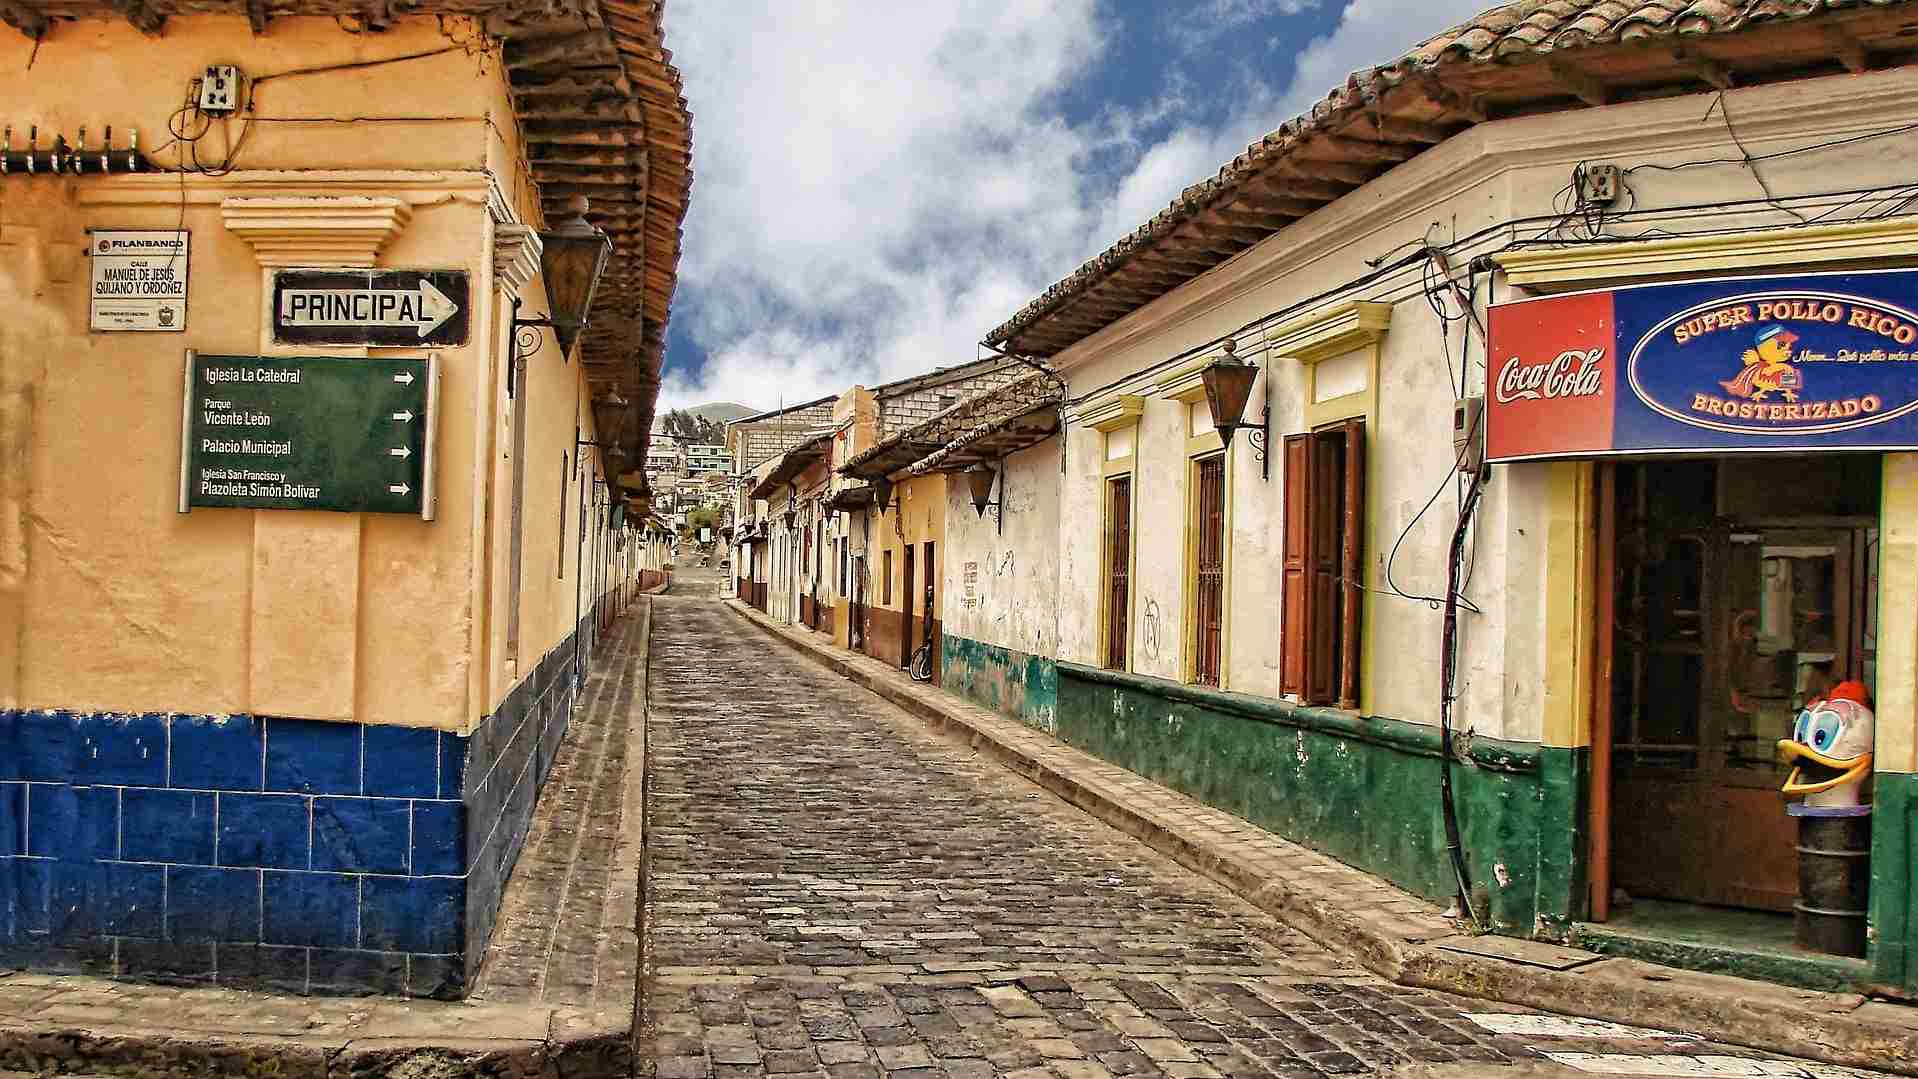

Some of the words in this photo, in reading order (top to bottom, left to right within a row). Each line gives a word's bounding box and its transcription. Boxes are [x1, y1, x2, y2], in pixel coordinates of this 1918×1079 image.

[104, 268, 137, 281] MANUEL
[139, 268, 150, 281] DE
[95, 281, 134, 294] QUIJANO
[135, 281, 142, 294] Y
[291, 294, 434, 322] PRINCIPAL
[1674, 305, 1752, 344] SUPER
[1758, 303, 1844, 322] POLLO
[1848, 308, 1916, 344] RICO
[206, 368, 239, 385] Iglesia
[241, 368, 255, 382] La
[256, 368, 300, 383] Catedral
[1496, 347, 1605, 403] Coca-Cola
[205, 398, 231, 411] Parque
[1692, 393, 1880, 420] BROSTERIZADO
[204, 411, 243, 425] Vicente
[245, 411, 271, 426] León
[203, 439, 240, 454] Palacio
[242, 440, 291, 458] Municipal
[202, 468, 226, 481] Iglesia
[227, 469, 242, 480] San
[243, 470, 280, 481] Francisco
[280, 473, 286, 483] y
[201, 481, 248, 497] Plazoleta
[249, 482, 281, 497] Simón
